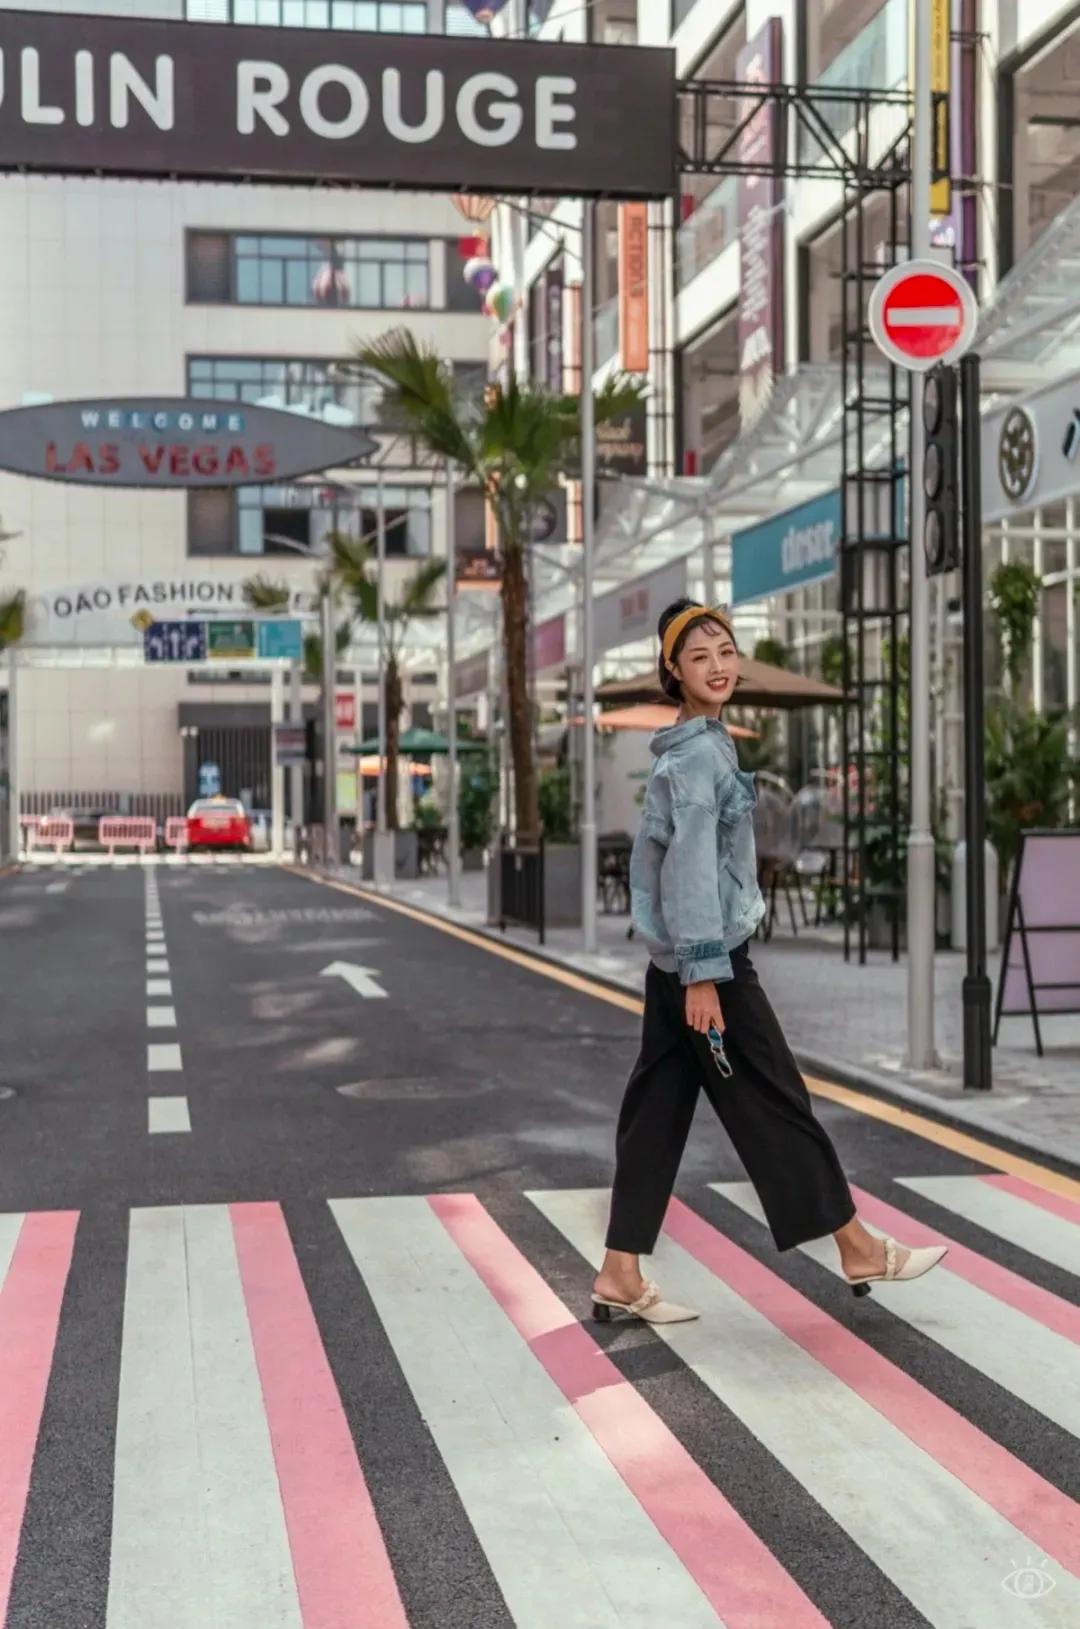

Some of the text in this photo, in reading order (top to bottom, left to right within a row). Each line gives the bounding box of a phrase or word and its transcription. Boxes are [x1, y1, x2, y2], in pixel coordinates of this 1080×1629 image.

[0, 45, 578, 150] LIN ROUGE
[80, 409, 243, 431] WELCOME
[45, 441, 276, 476] LAS VEGAS
[117, 580, 234, 606] FASHION
